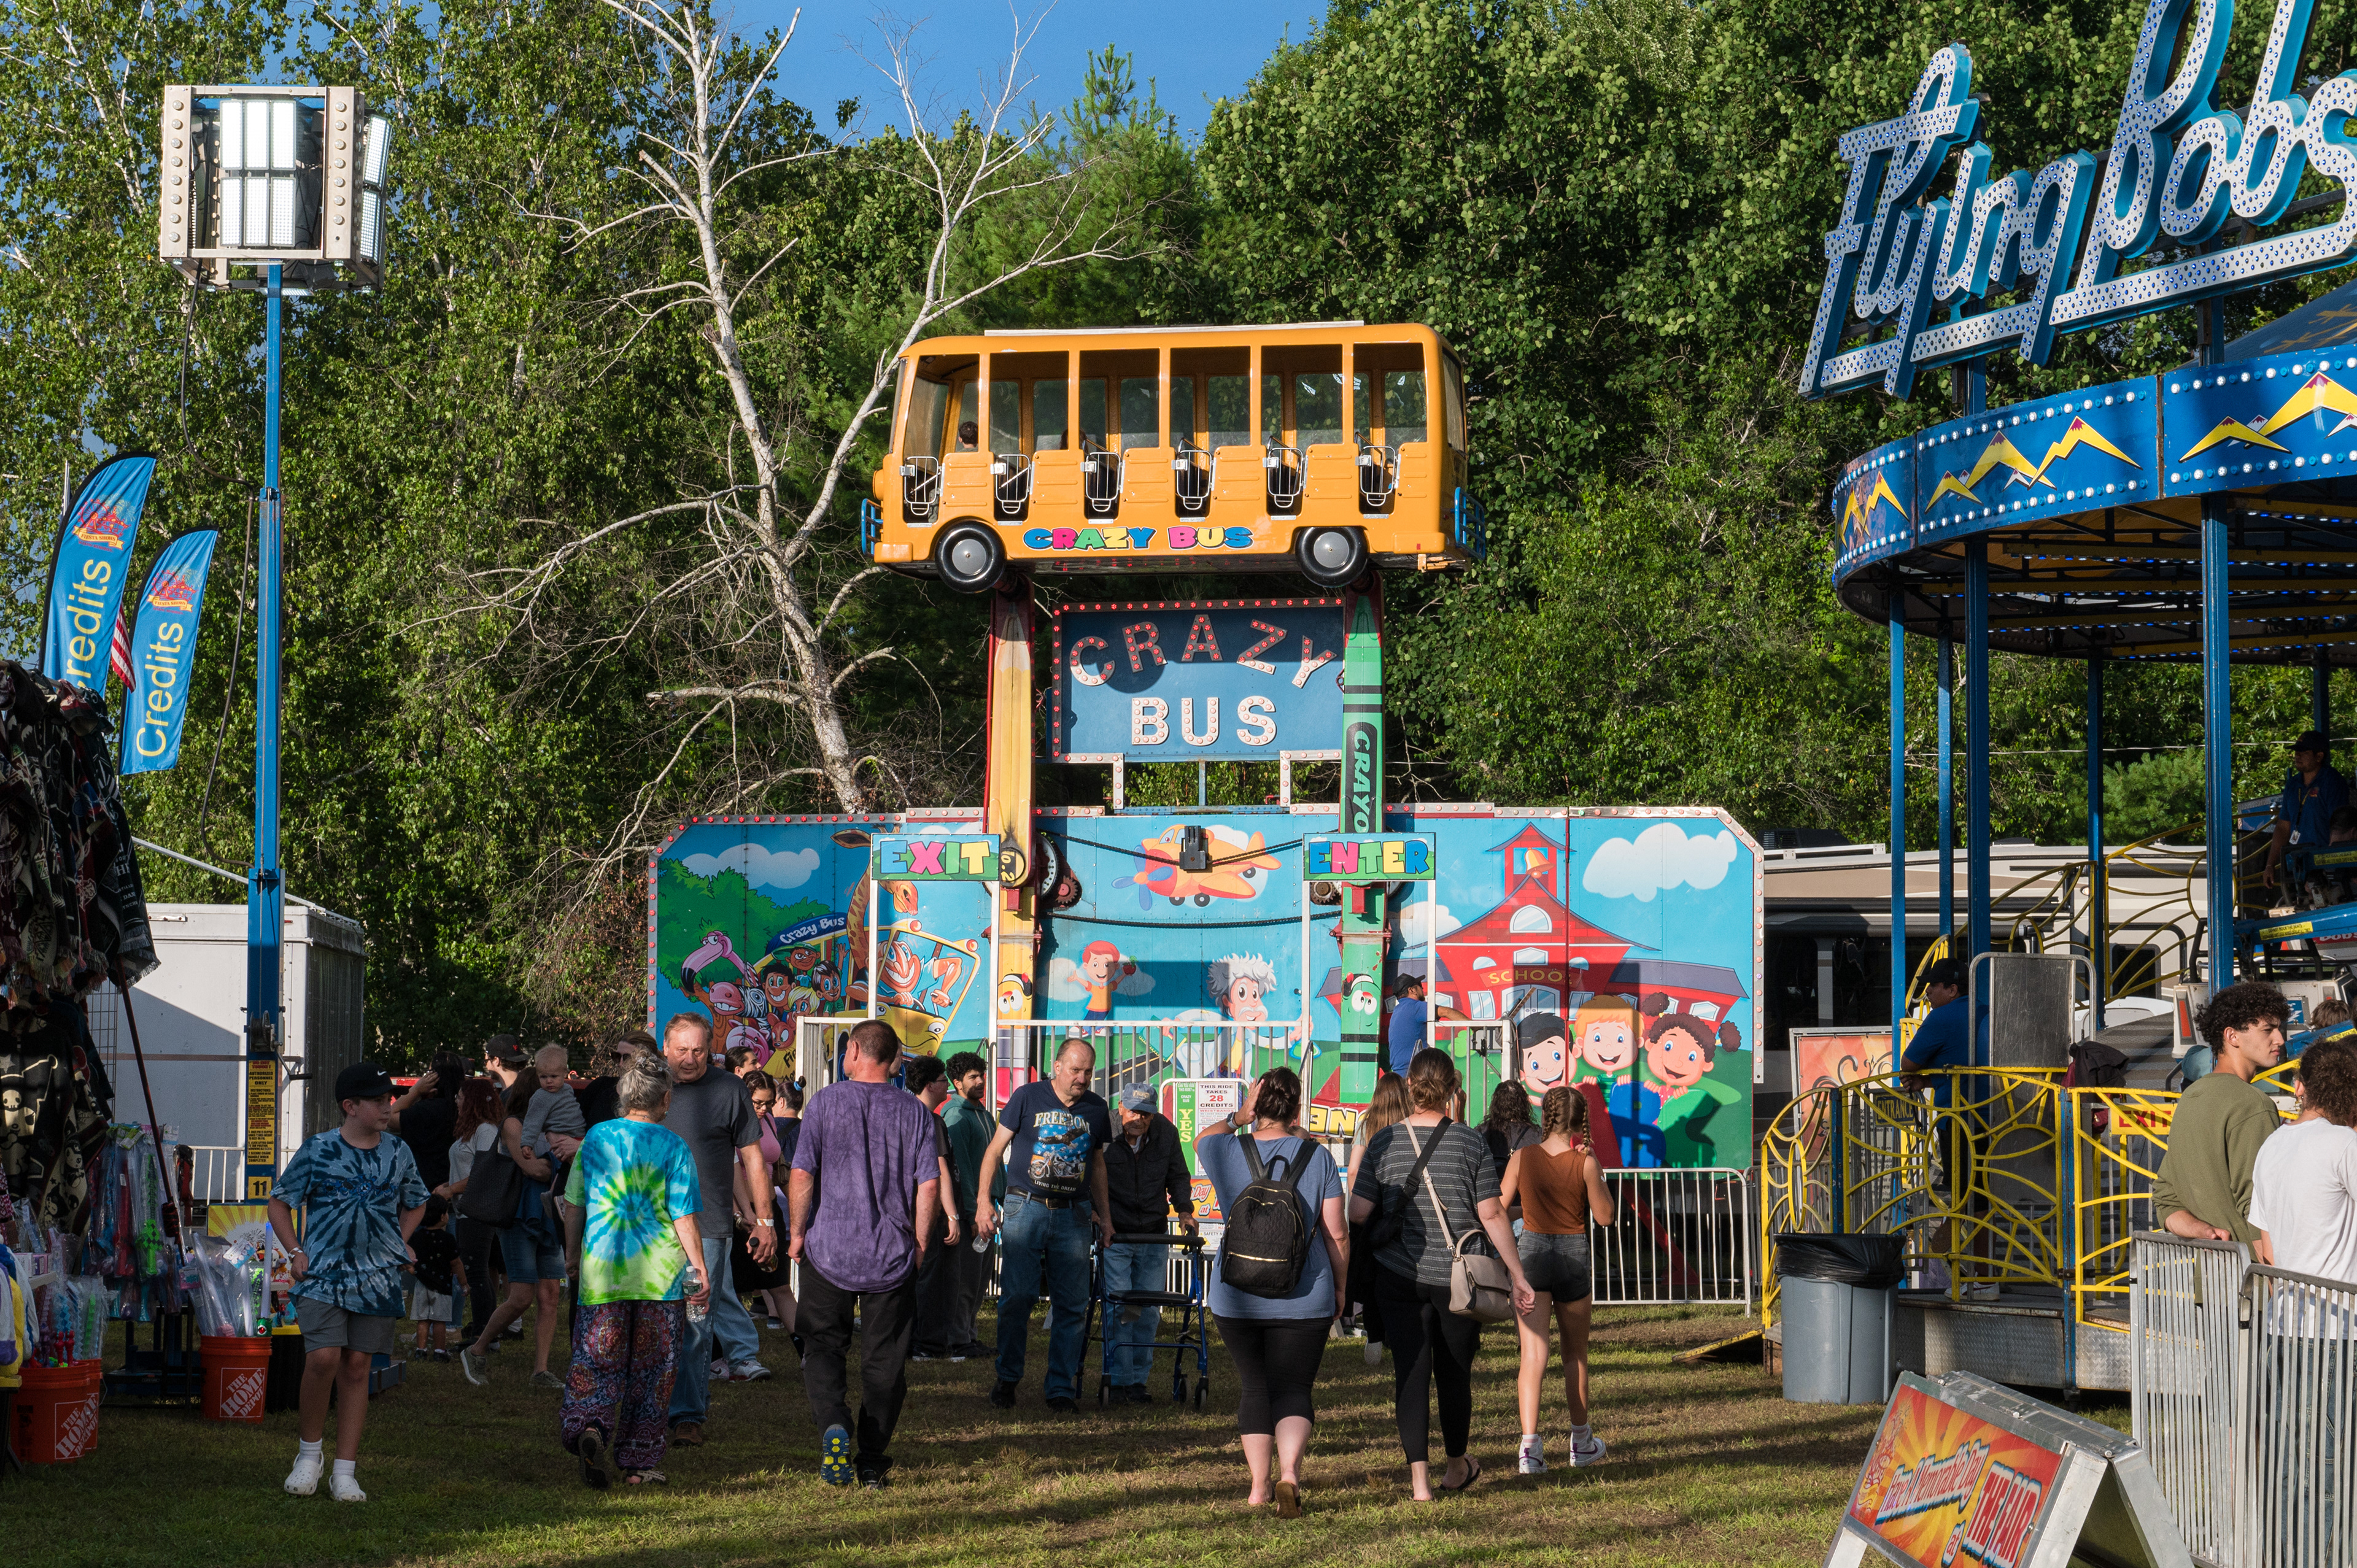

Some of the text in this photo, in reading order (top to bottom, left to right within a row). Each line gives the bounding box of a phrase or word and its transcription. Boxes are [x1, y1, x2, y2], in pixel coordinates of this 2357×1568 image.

[1798, 42, 2096, 402] Flying
[1024, 526, 1253, 550] CRAZY BUS
[66, 559, 112, 687] redits
[1069, 614, 1338, 689] CRAZY
[136, 622, 184, 757] Credits
[1131, 695, 1277, 746] BUS
[880, 840, 991, 876] EXIT
[1307, 840, 1430, 875] ENTER
[780, 917, 845, 944] Crazy Bus
[1033, 1110, 1091, 1136] FREEDOM
[1877, 1099, 1914, 1119] ENTRANCE
[2118, 1110, 2172, 1128] EXIT
[1179, 1109, 1193, 1143] YES
[252, 1180, 267, 1196] 11
[1034, 1180, 1050, 1188] LIVING
[1193, 1186, 1210, 1200] Day
[220, 1369, 266, 1417] HOME
[226, 1373, 248, 1394] THE
[238, 1390, 263, 1418] DEPOT
[61, 1407, 80, 1431] THE
[1880, 1449, 1986, 1513] Have A Memorable Day
[1966, 1471, 2038, 1564] THE FAIR
[1946, 1530, 1962, 1556] at
